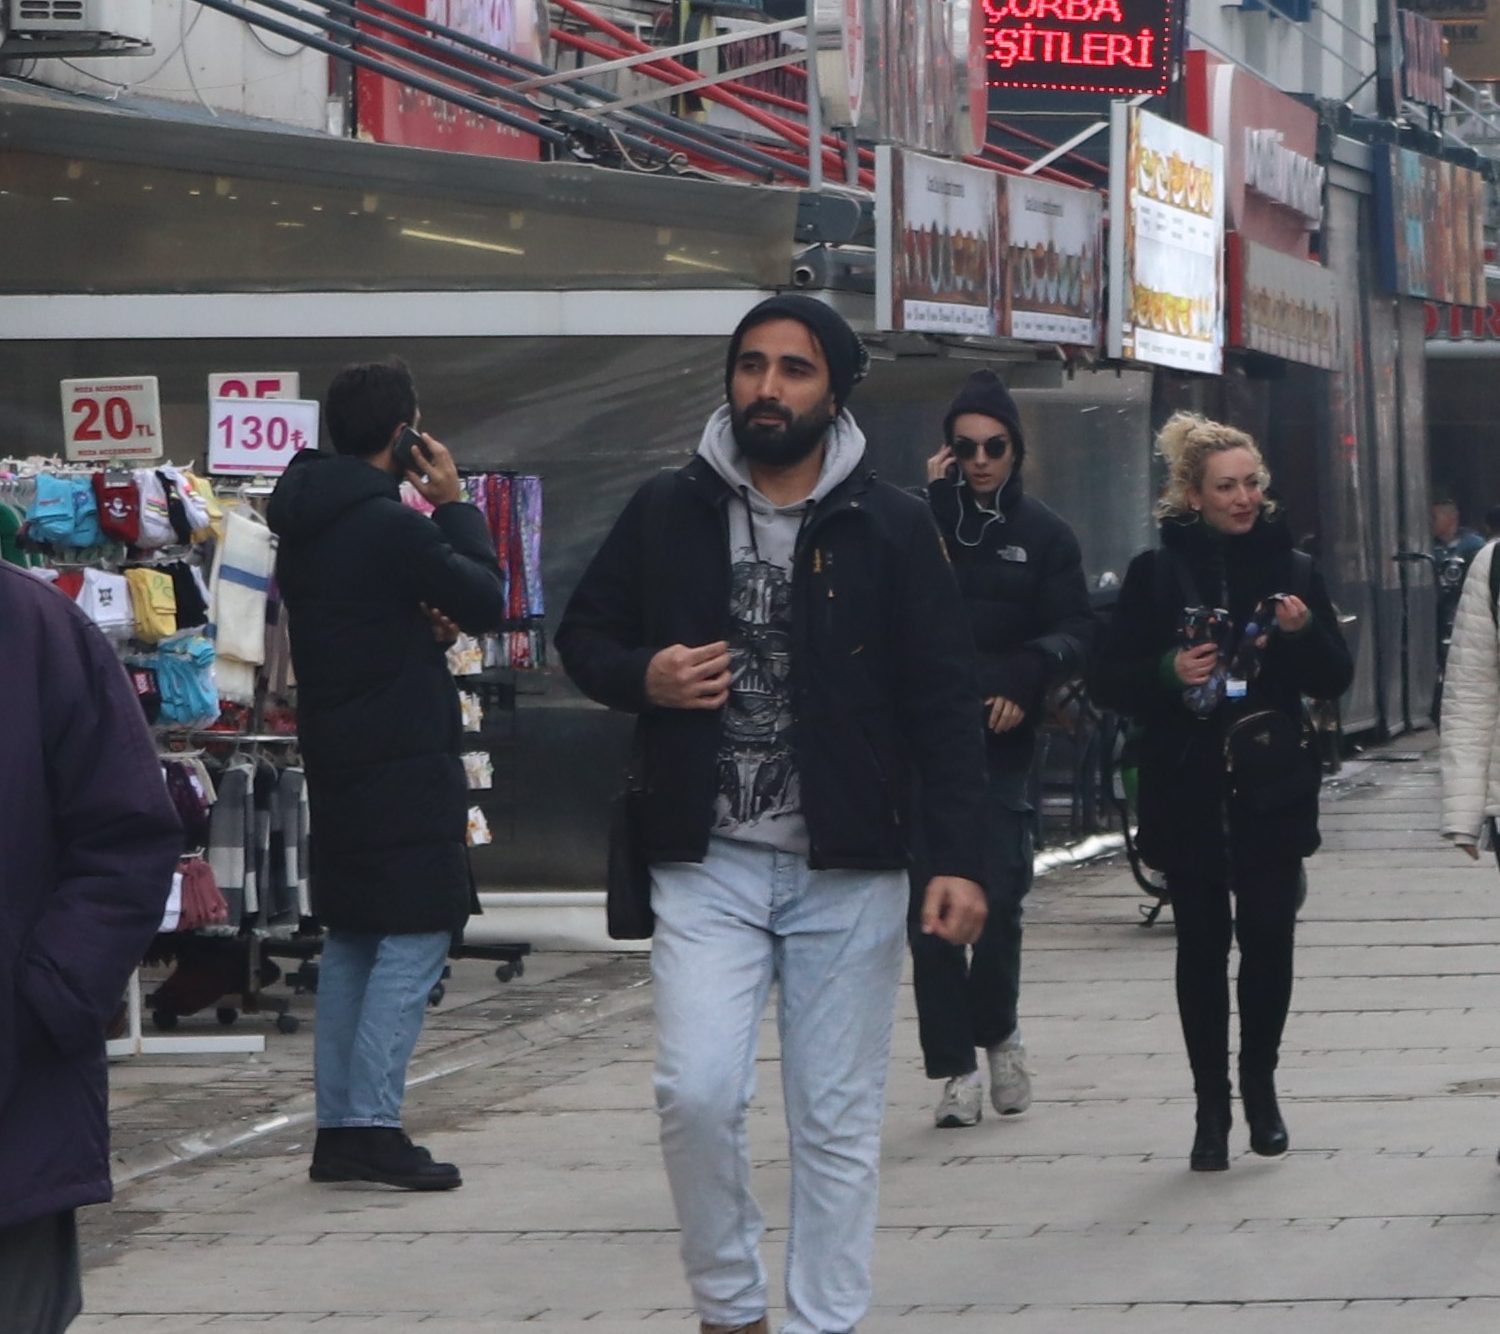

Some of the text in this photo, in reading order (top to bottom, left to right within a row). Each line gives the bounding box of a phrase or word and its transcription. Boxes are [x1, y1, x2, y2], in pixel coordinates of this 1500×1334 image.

[983, 22, 1154, 68] EŞİTLERİ
[71, 396, 156, 442] 20 TL
